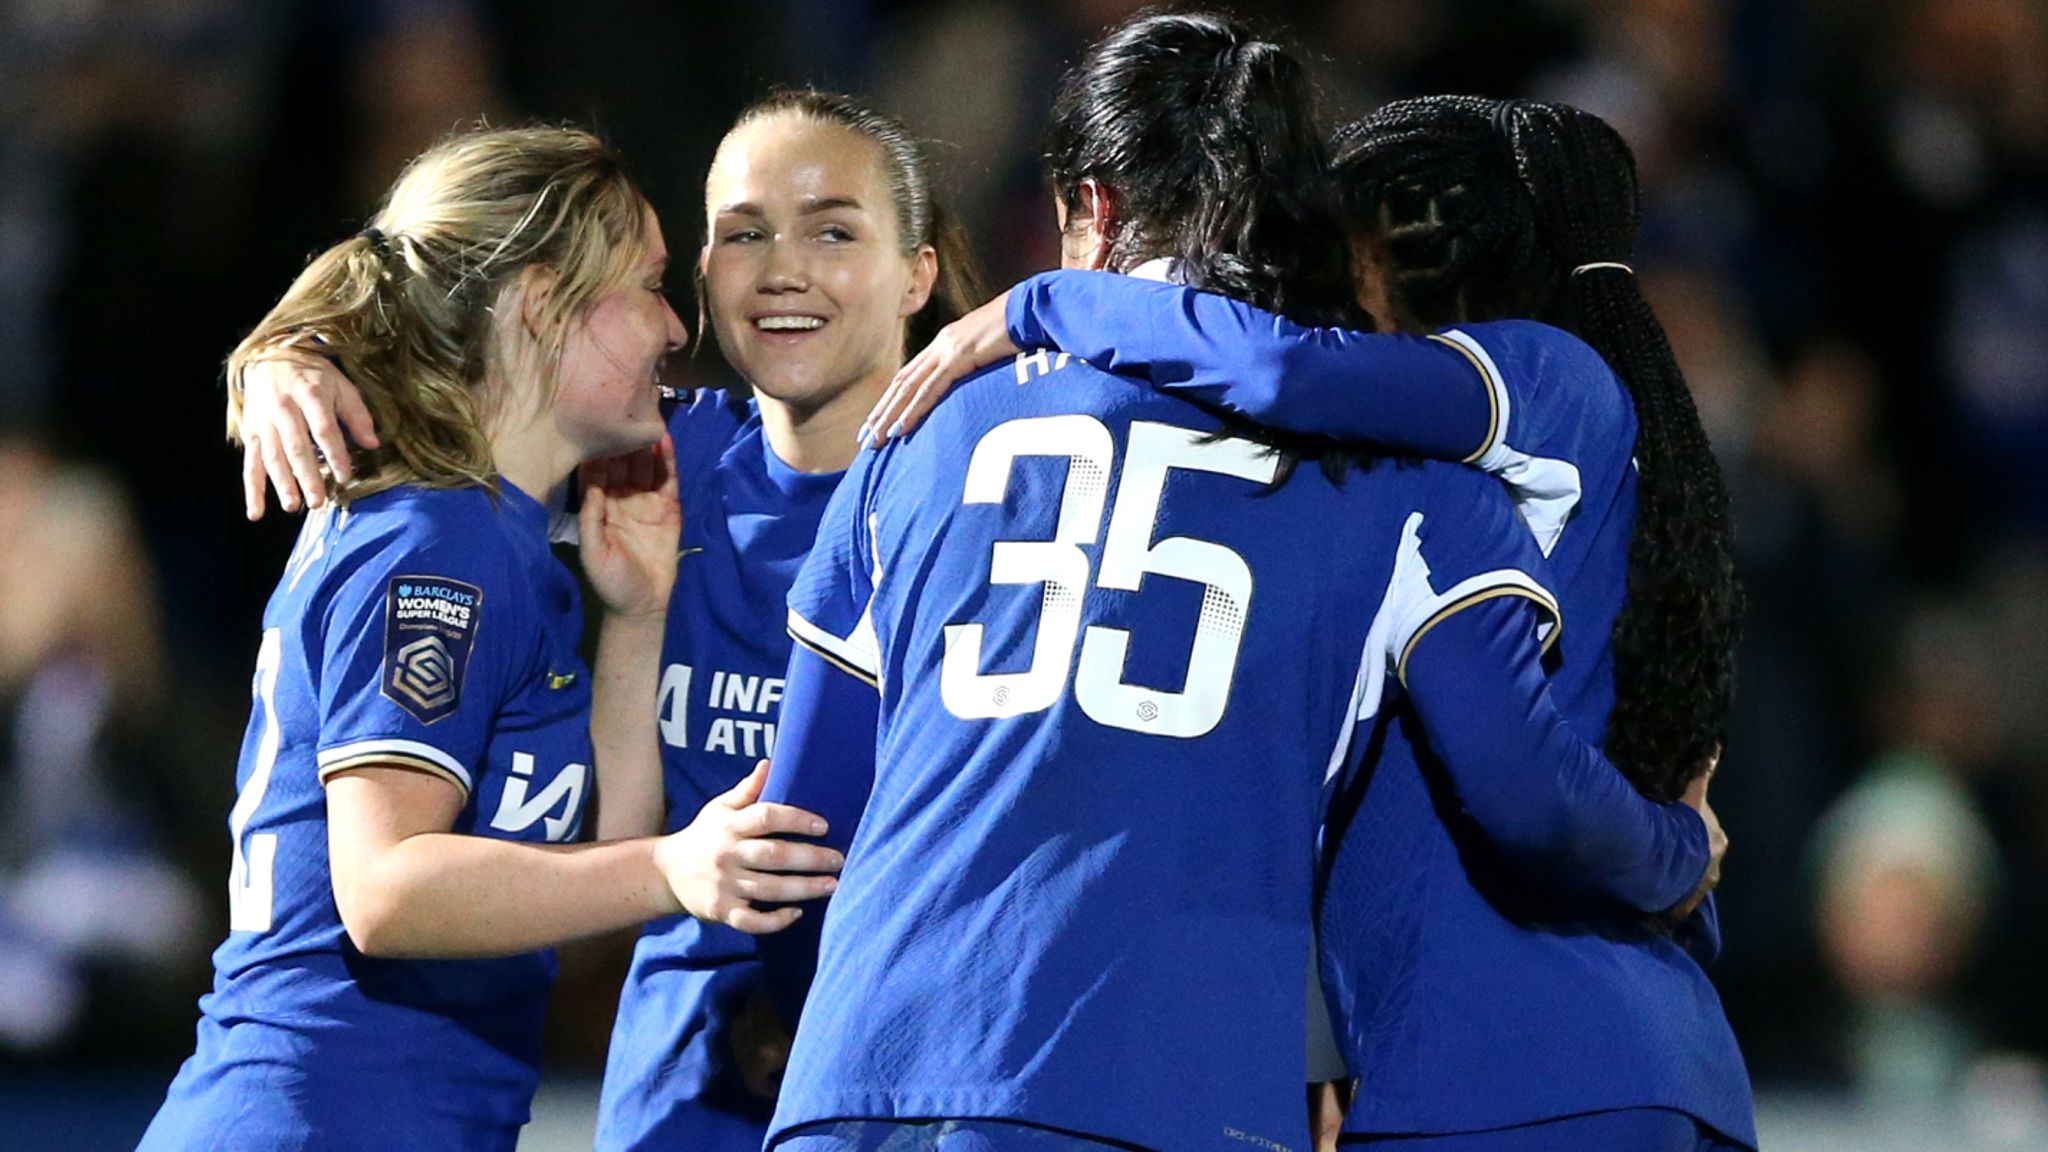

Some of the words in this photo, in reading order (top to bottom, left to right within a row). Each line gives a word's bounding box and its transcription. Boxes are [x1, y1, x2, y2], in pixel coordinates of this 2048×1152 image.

[940, 414, 1281, 738] 35
[414, 586, 474, 605] BARCLAYS
[398, 598, 470, 619] WOMEN'S
[397, 609, 430, 619] SUPER
[432, 611, 468, 629] LEAGUE
